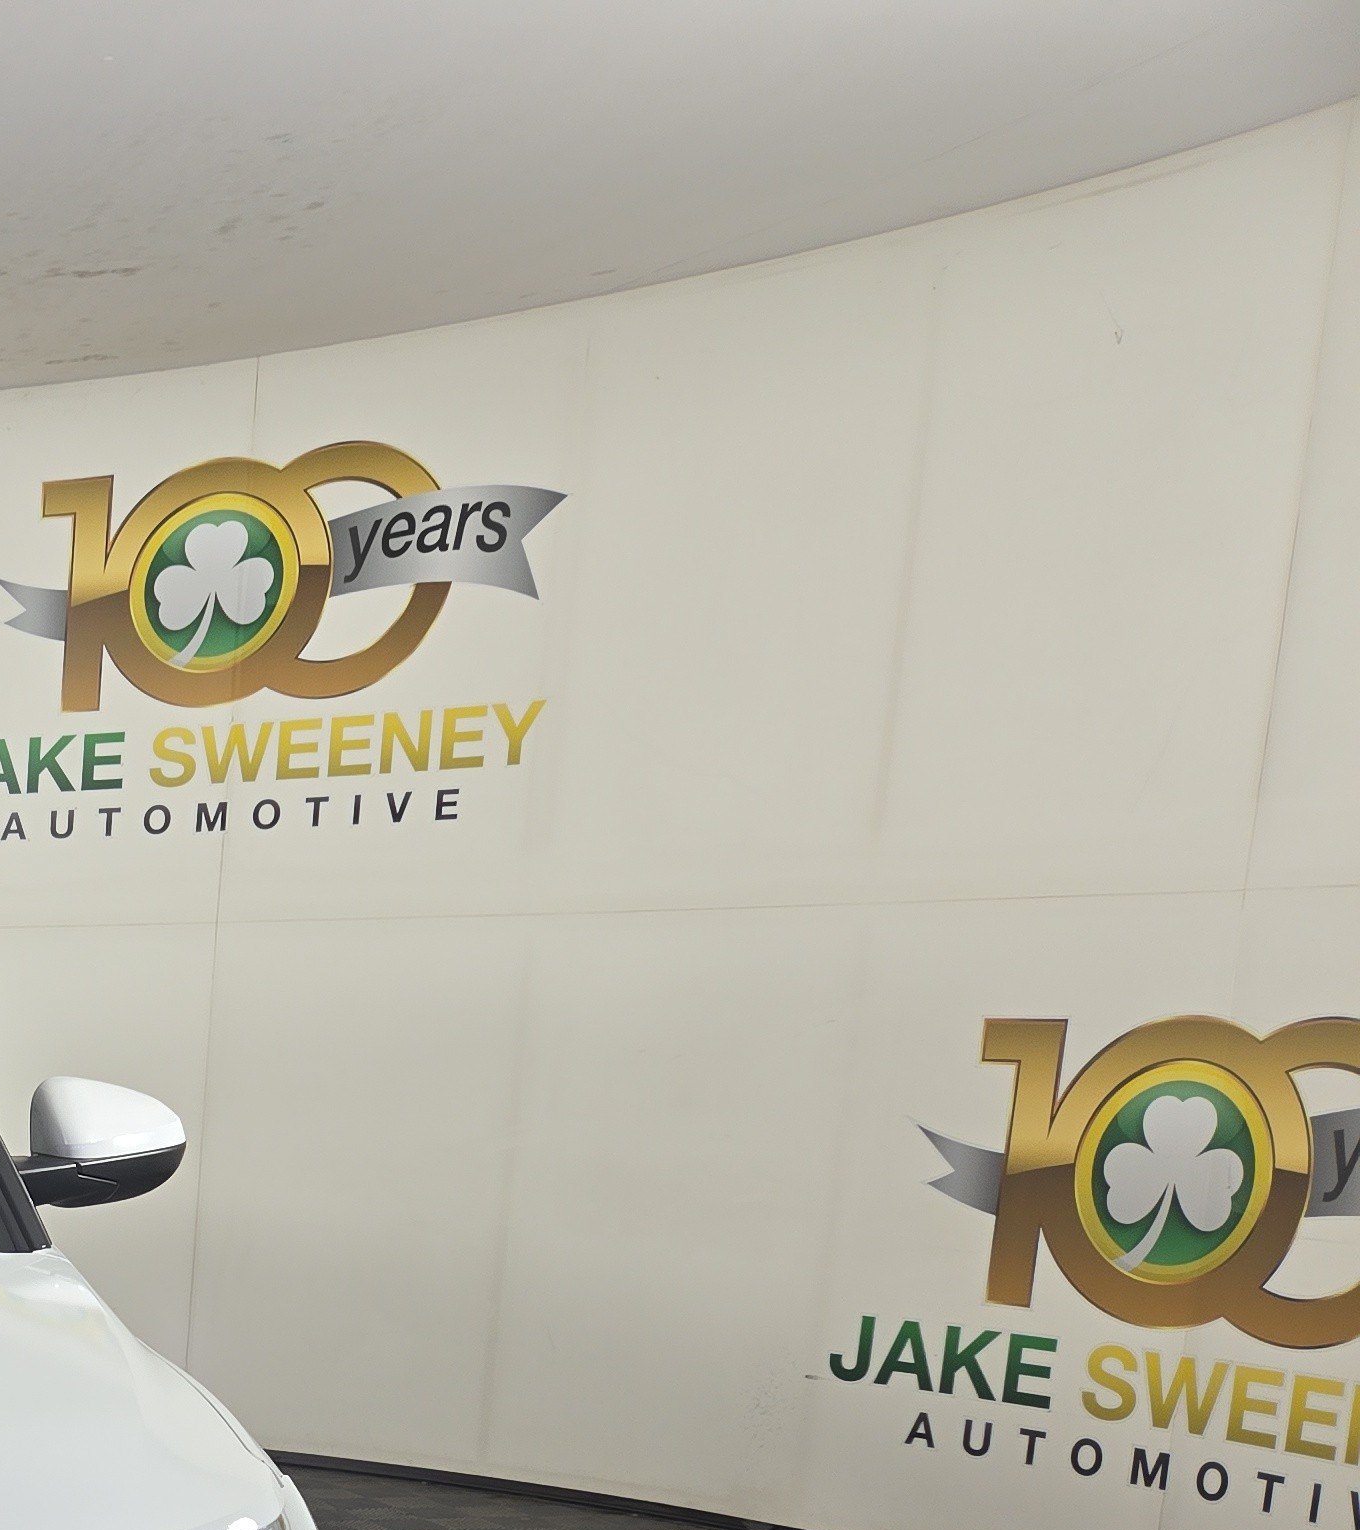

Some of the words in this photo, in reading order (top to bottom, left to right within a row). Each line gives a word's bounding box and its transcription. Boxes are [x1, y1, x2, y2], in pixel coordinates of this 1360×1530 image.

[343, 499, 511, 583] years
[148, 699, 547, 787] SWEENEY
[0, 788, 460, 841] AUTOMOTIVE
[829, 1315, 1058, 1410] JAKE
